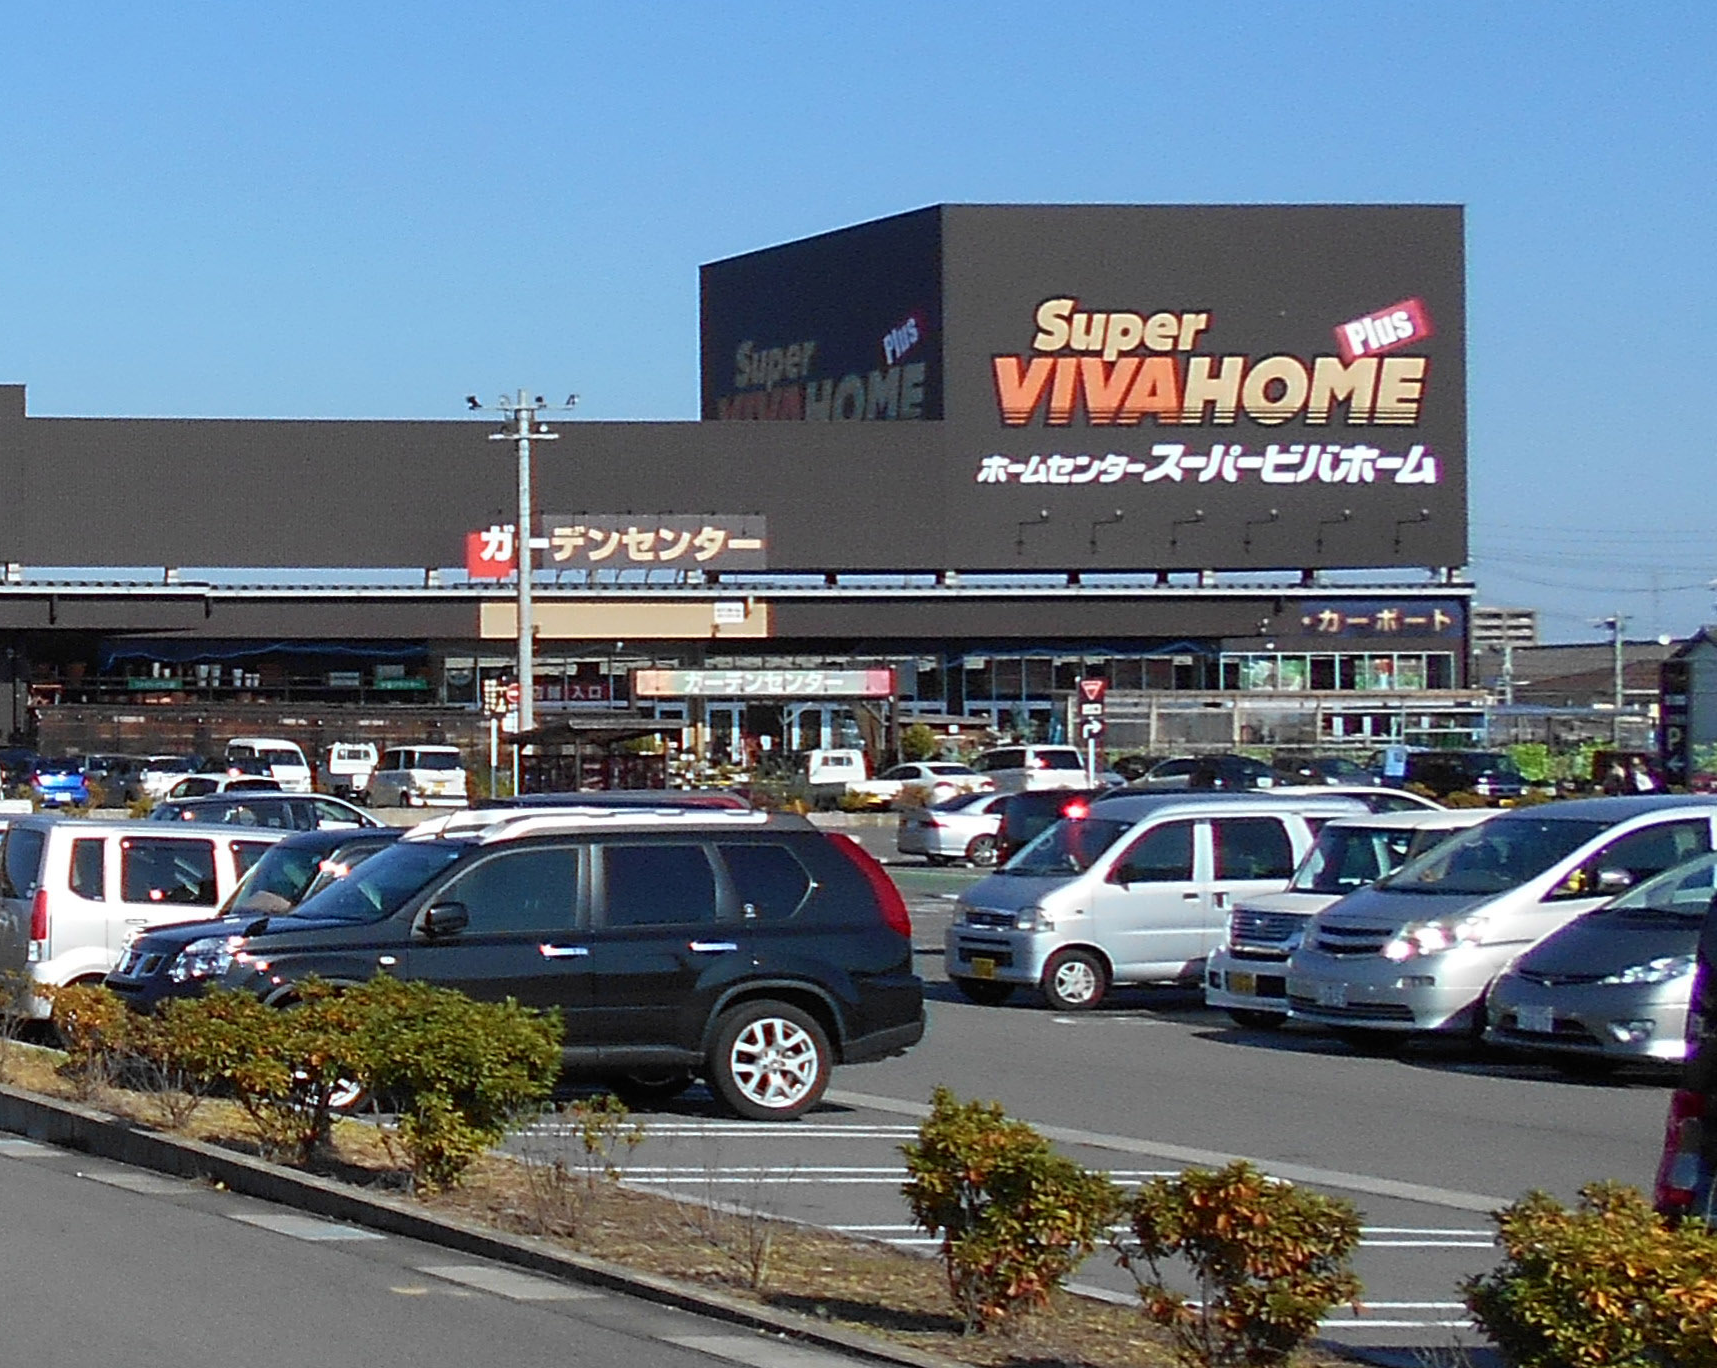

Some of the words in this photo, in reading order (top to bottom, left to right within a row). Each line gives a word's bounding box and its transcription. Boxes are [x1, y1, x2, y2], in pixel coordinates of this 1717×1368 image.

[883, 318, 919, 364] Plus
[1033, 299, 1208, 361] Super
[1345, 311, 1414, 355] Plus
[736, 340, 817, 392] Super
[995, 356, 1426, 424] VIVAHOME
[480, 525, 762, 561] ガーデンセンター
[684, 672, 844, 693] ガーデンセンター
